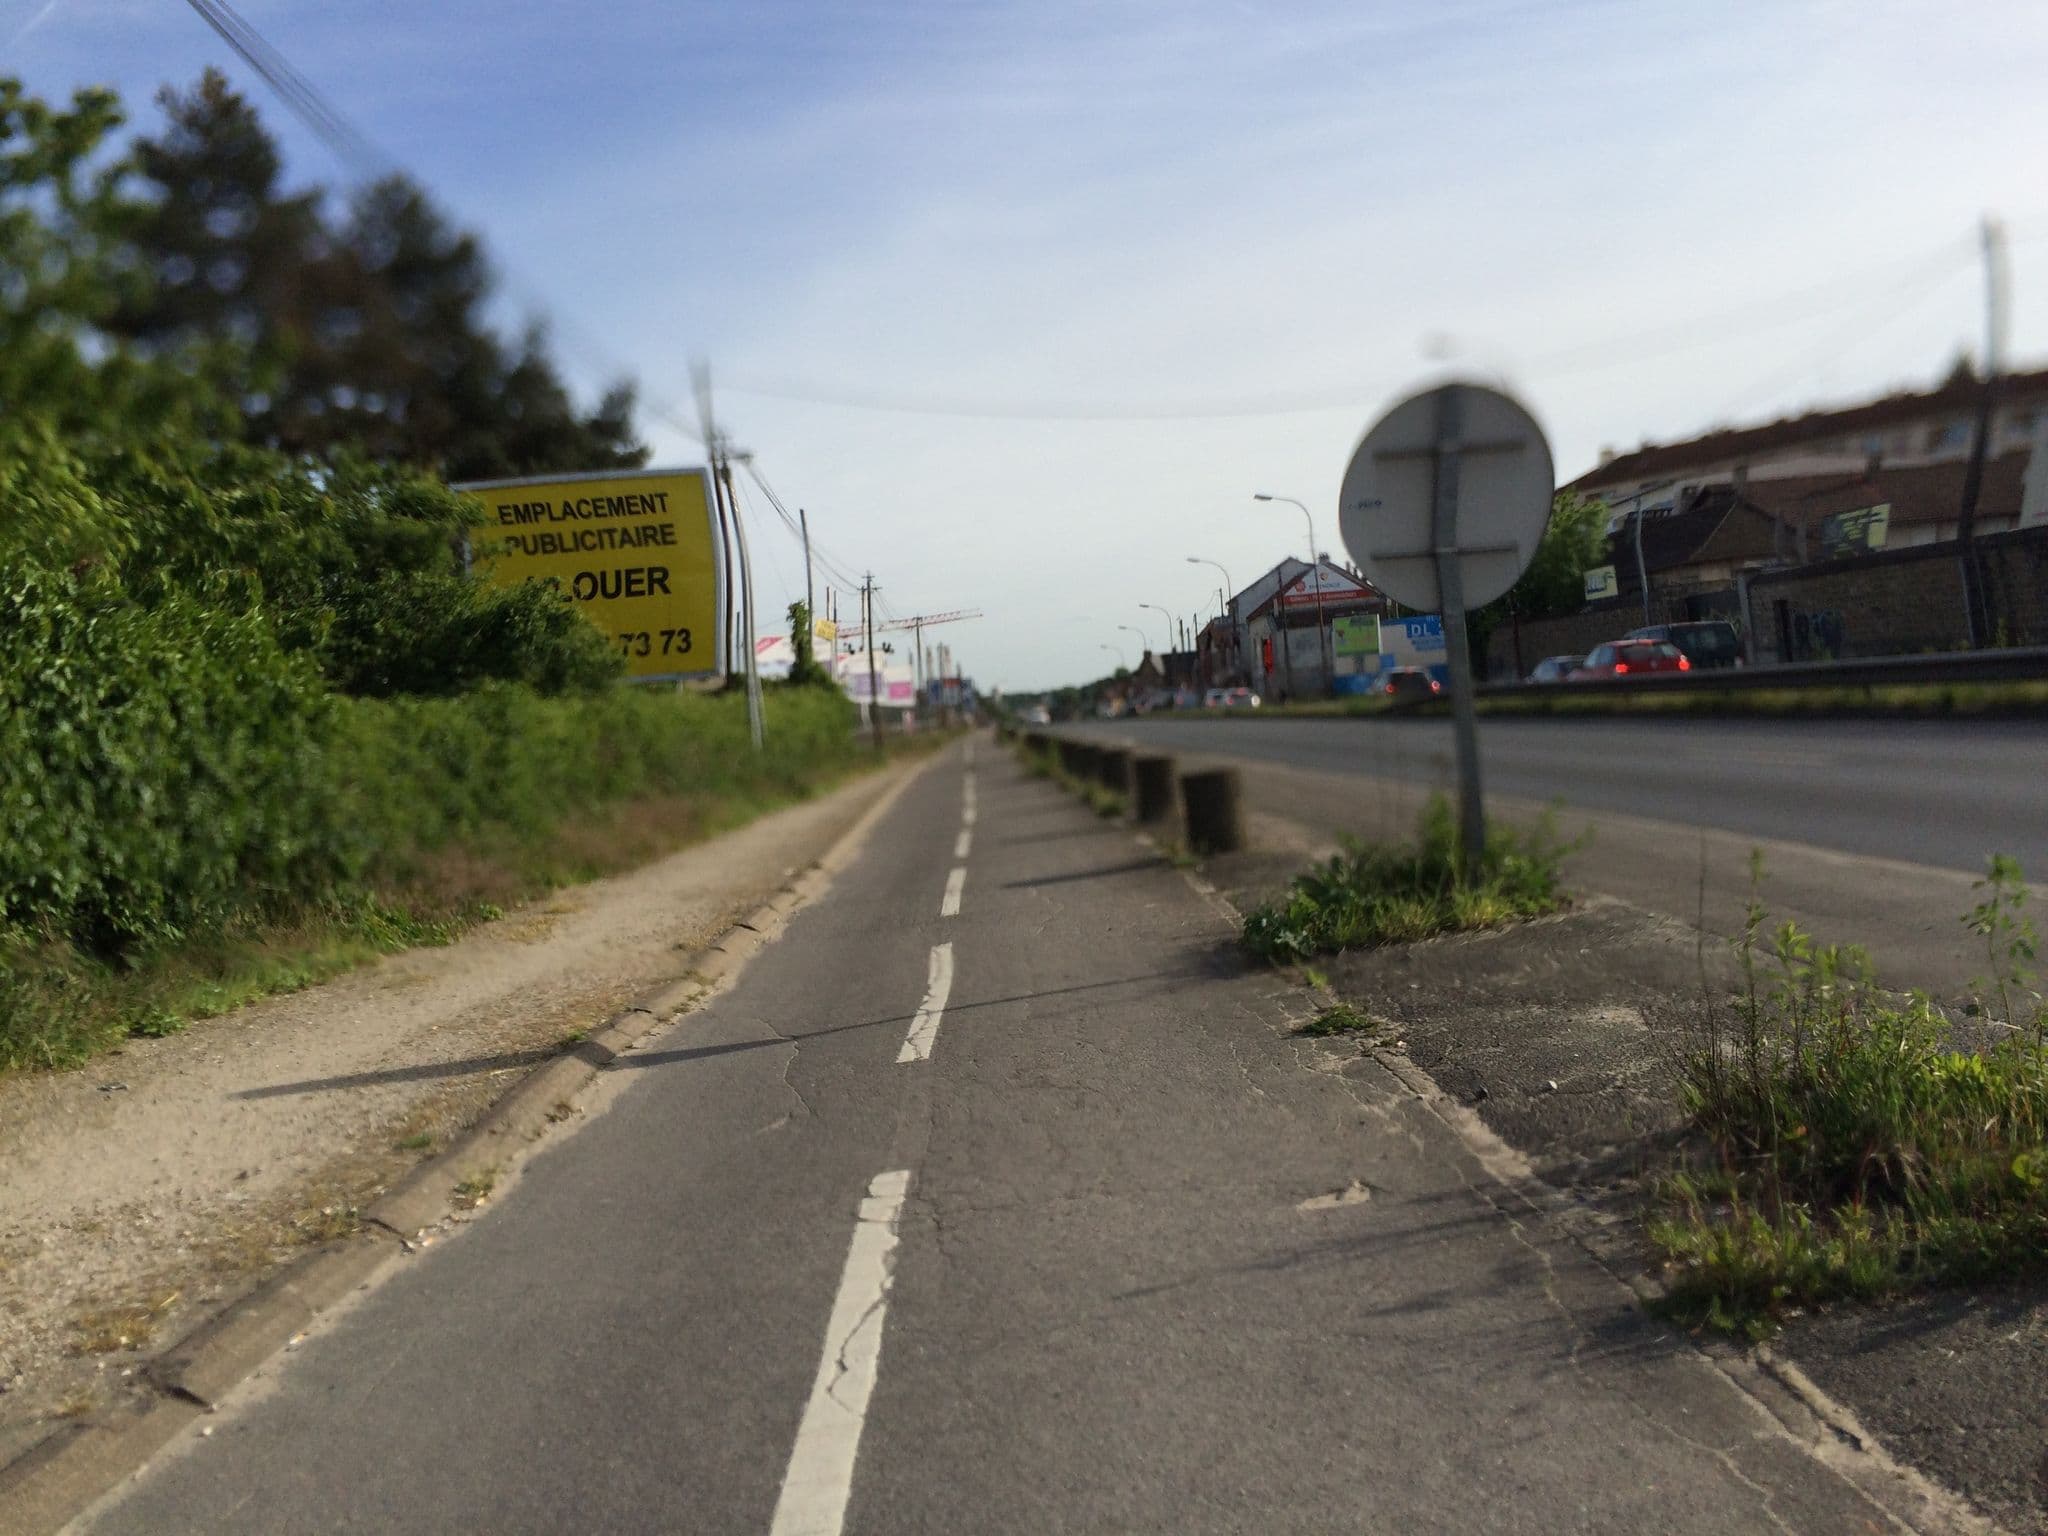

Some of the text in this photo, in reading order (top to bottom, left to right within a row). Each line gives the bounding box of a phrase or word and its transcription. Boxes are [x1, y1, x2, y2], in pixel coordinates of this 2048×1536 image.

[497, 493, 668, 525] EMPLACEMENT
[504, 524, 676, 557] PUBLICITAIRE
[619, 632, 651, 657] 73
[660, 628, 692, 655] 73
